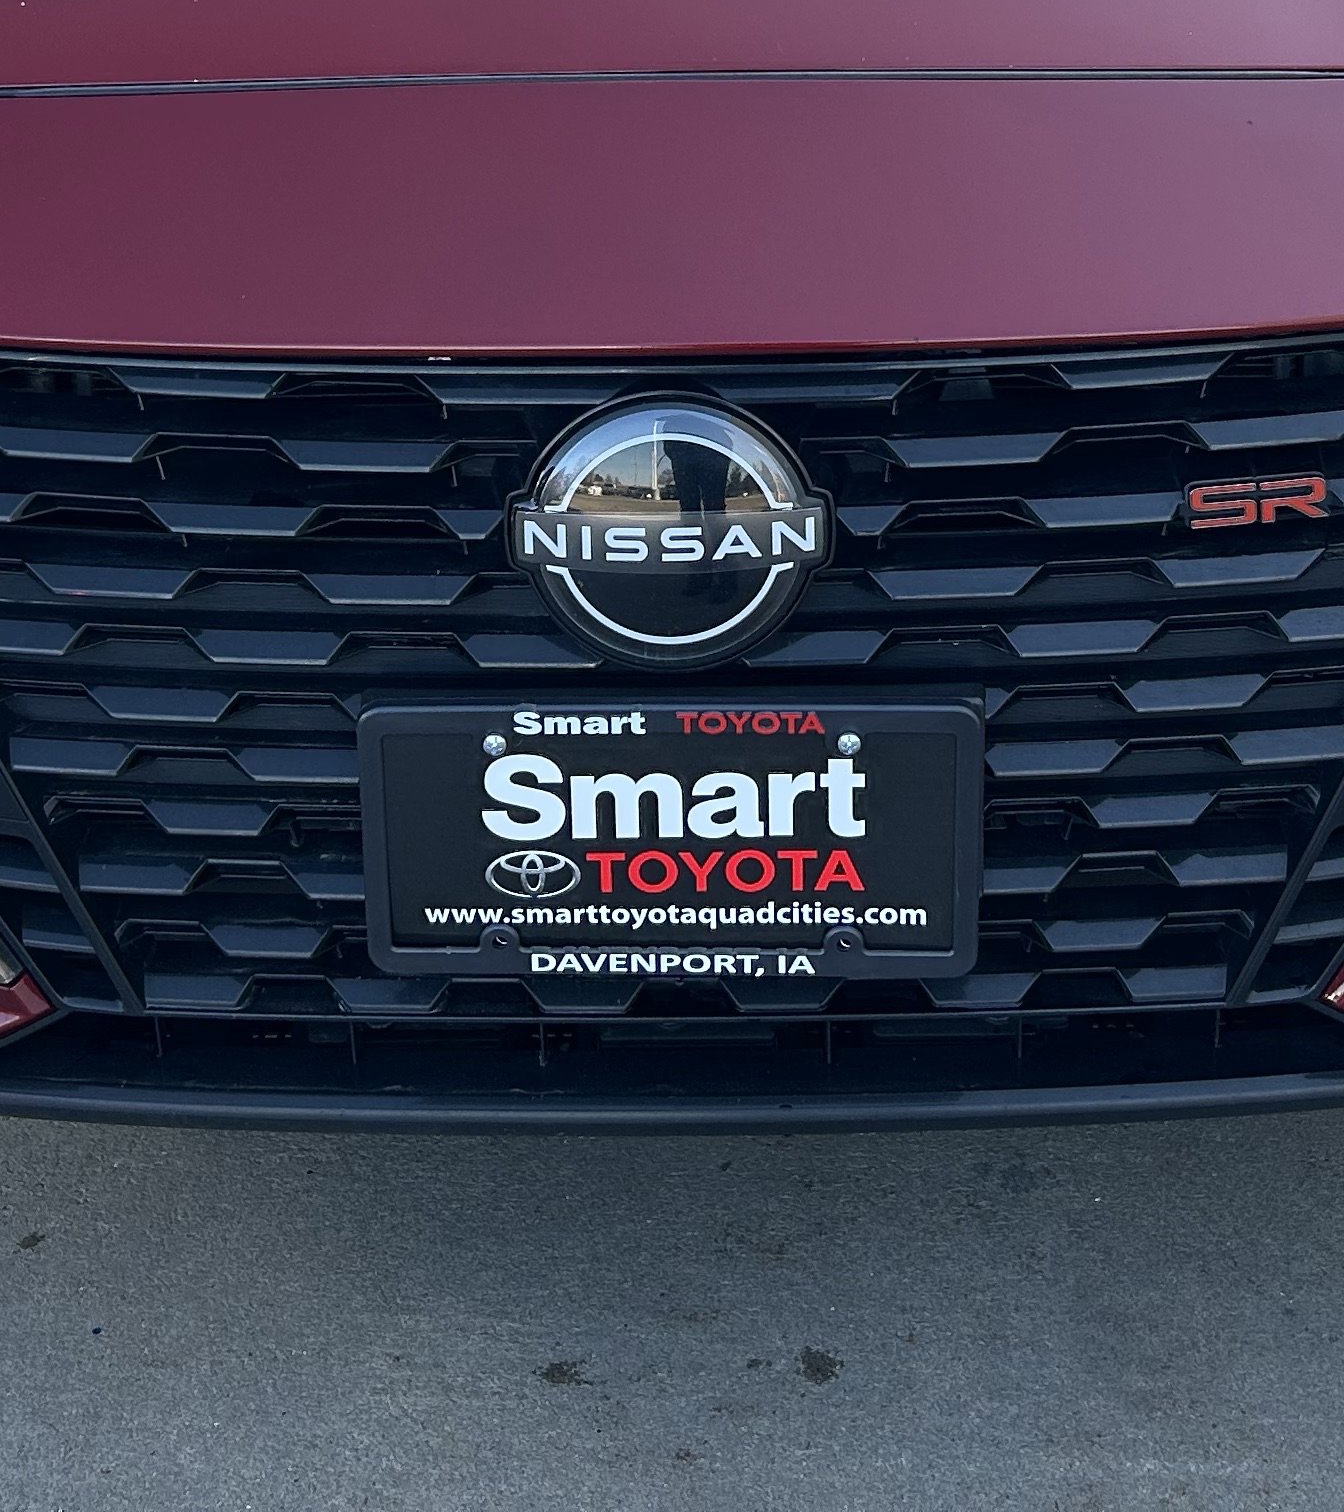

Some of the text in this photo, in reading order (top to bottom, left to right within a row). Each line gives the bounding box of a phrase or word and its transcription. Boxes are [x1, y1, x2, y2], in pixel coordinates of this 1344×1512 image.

[1189, 476, 1329, 529] SR
[523, 516, 816, 563] NISSAN
[513, 711, 826, 736] Smart TOYOTA
[481, 753, 867, 842] Smart
[584, 848, 866, 894] TOYOTA
[424, 901, 928, 930] www.smarttoyotaquadcities.com
[530, 952, 816, 978] DAVENPORT, IA
